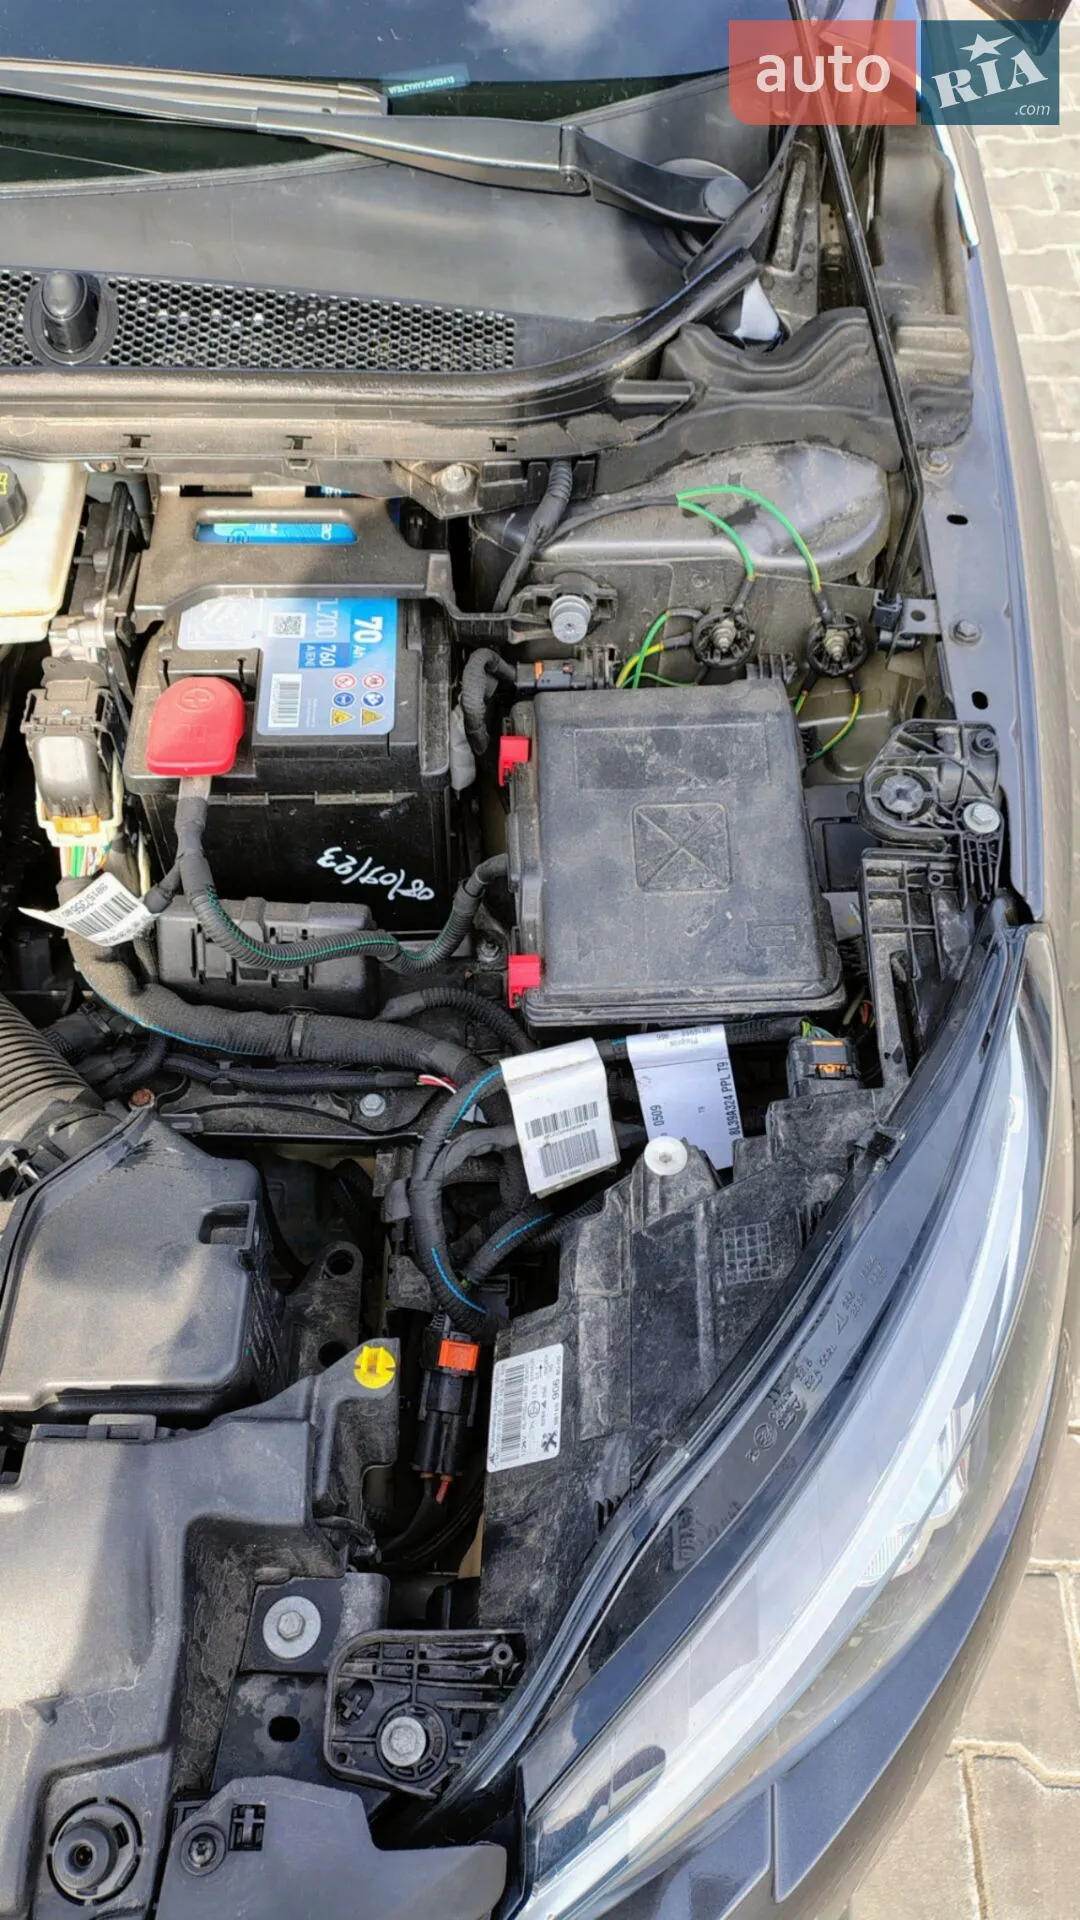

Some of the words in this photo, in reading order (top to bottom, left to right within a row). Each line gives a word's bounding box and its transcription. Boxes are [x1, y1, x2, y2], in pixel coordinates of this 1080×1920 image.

[353, 615, 384, 643] 70
[318, 644, 337, 667] 760
[352, 644, 366, 659] Ah
[717, 1061, 730, 1073] T9
[721, 1074, 733, 1093] PPL
[649, 1104, 665, 1127] 0509
[723, 1094, 741, 1137] 8L39A324
